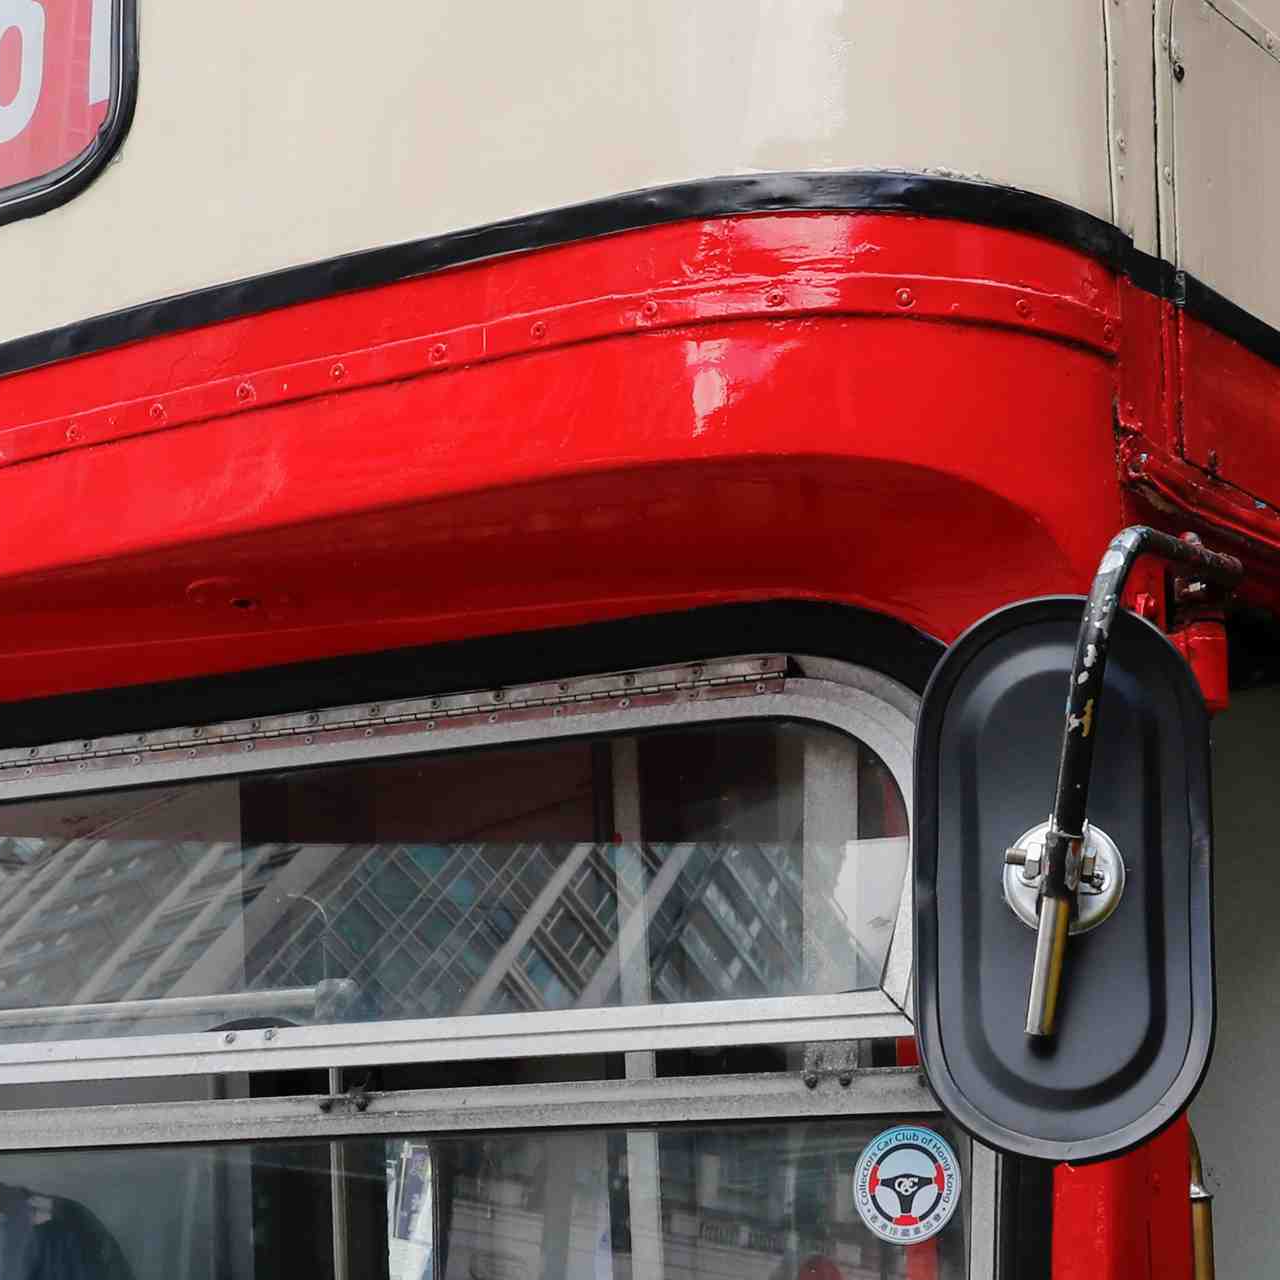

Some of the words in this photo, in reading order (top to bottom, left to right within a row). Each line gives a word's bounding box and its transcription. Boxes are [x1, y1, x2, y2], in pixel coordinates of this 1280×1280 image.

[877, 1138, 893, 1152] Car
[894, 1130, 919, 1142] Club
[921, 1135, 933, 1146] of
[932, 1142, 952, 1172] Hong
[942, 1173, 954, 1204] Kong
